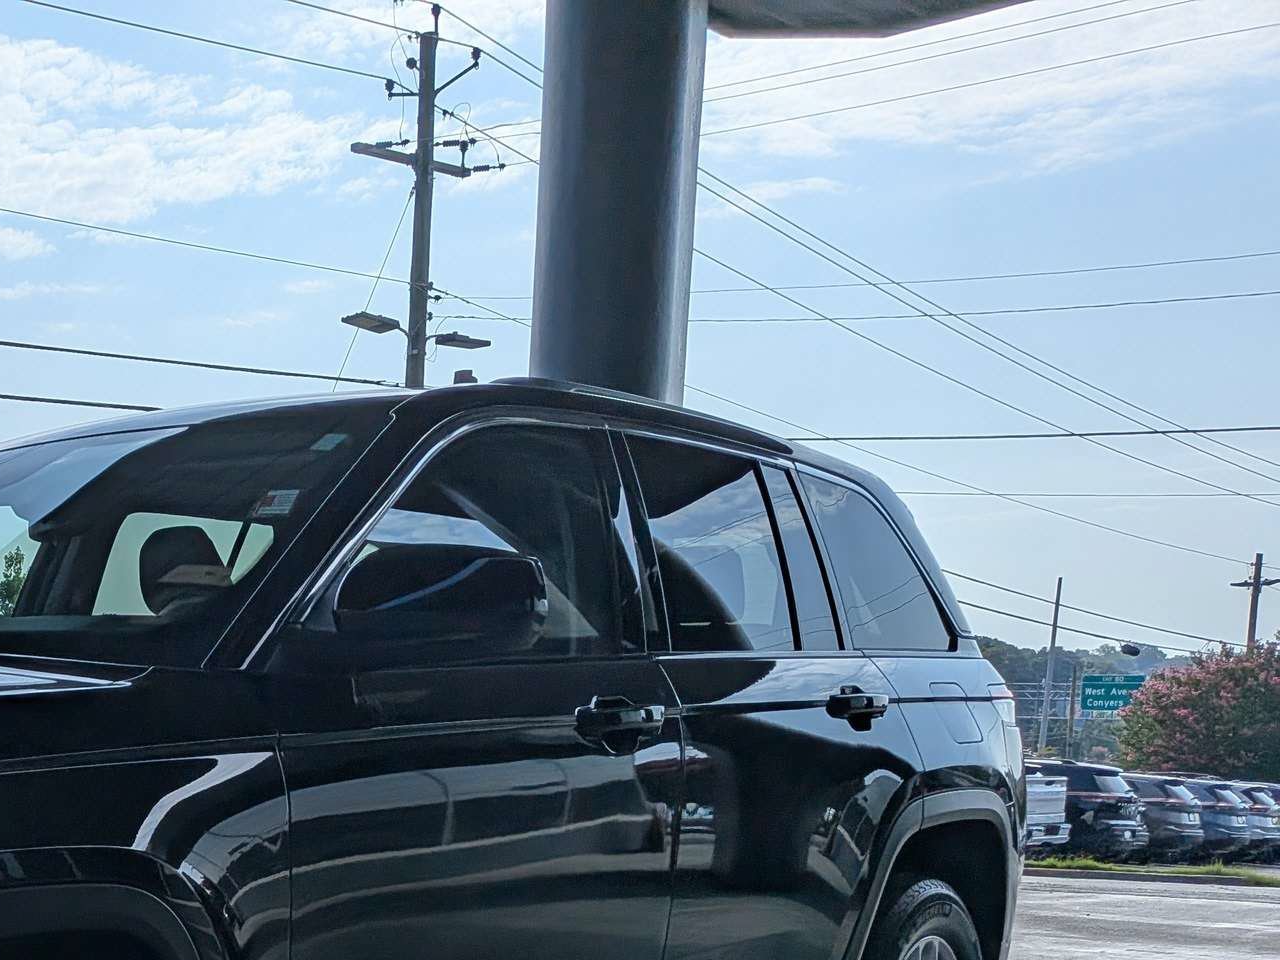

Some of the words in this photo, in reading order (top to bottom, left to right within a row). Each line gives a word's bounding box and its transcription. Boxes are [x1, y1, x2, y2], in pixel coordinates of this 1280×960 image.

[1085, 687, 1105, 696] West
[1110, 687, 1128, 696] Ave
[1086, 698, 1124, 709] Conyers
